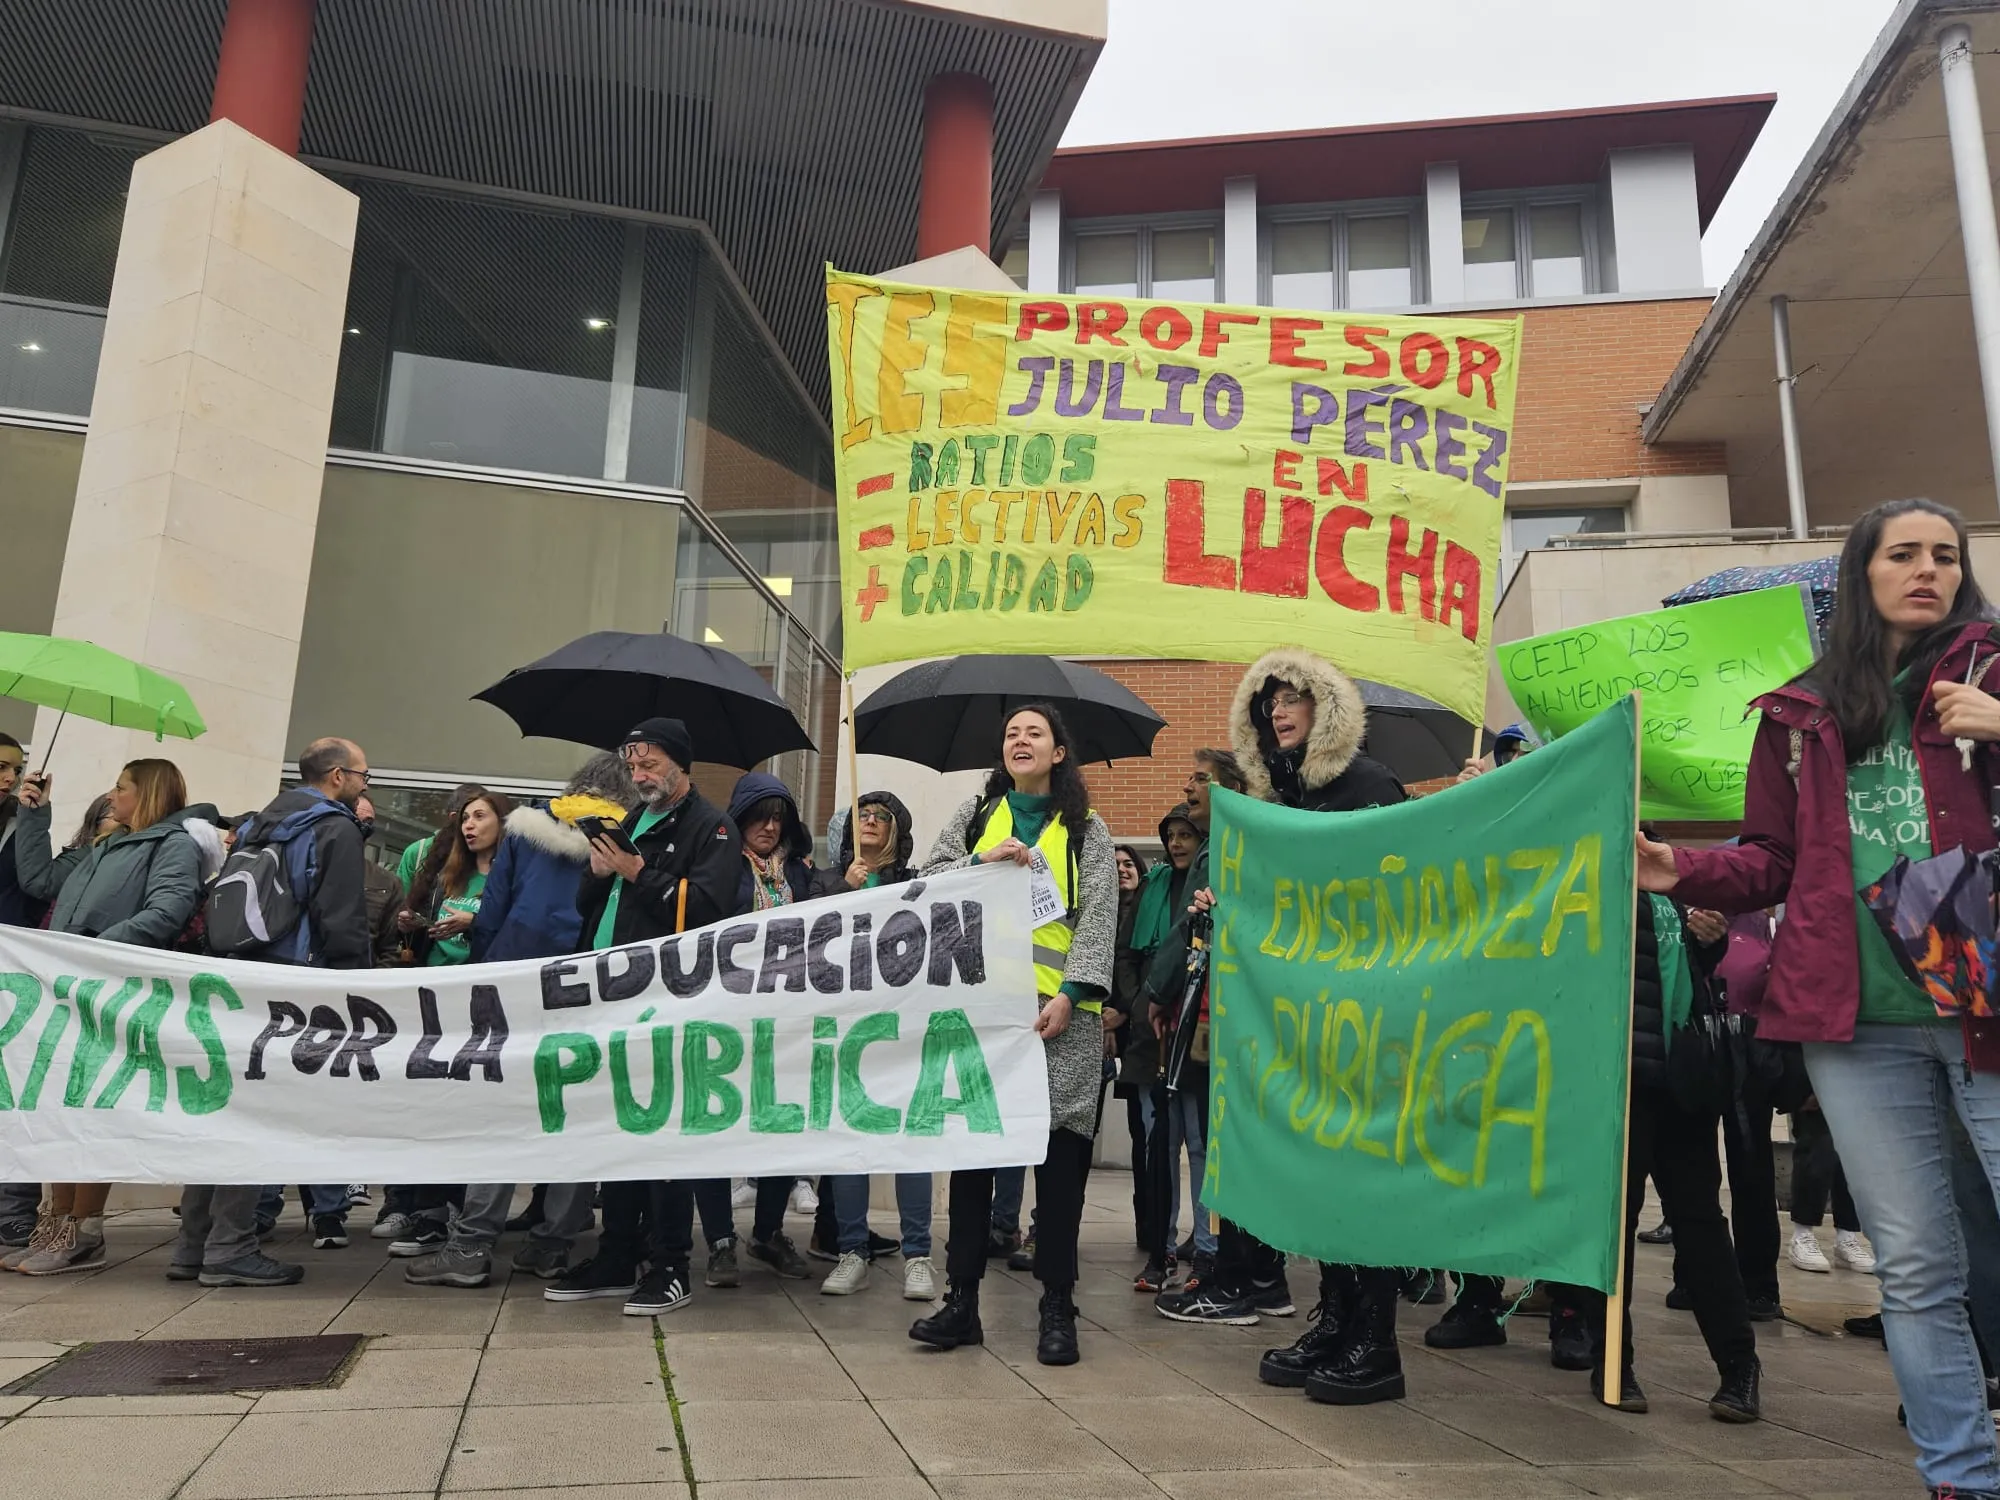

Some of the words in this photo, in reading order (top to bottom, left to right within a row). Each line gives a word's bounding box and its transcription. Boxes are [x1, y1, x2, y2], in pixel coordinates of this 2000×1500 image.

[826, 282, 1009, 452] IES
[1015, 300, 1500, 410] PROFESOR
[909, 433, 1096, 492] RATIOS
[1008, 356, 1244, 430] JULIO
[1291, 382, 1507, 498] PÉREZ
[1273, 449, 1369, 502] EN
[906, 490, 1146, 552] LECTIVAS
[901, 550, 1094, 616] CALIDAD
[1163, 478, 1481, 643] LUCHA
[1509, 631, 1597, 682] CEIP
[1629, 620, 1689, 658] LOS
[1527, 665, 1699, 719] ALMENDROS
[1716, 647, 1766, 684] EN
[1643, 717, 1697, 744] POR
[1259, 832, 1602, 972] ENSEÑANZA
[245, 993, 398, 1082] POR
[405, 984, 510, 1083] LA
